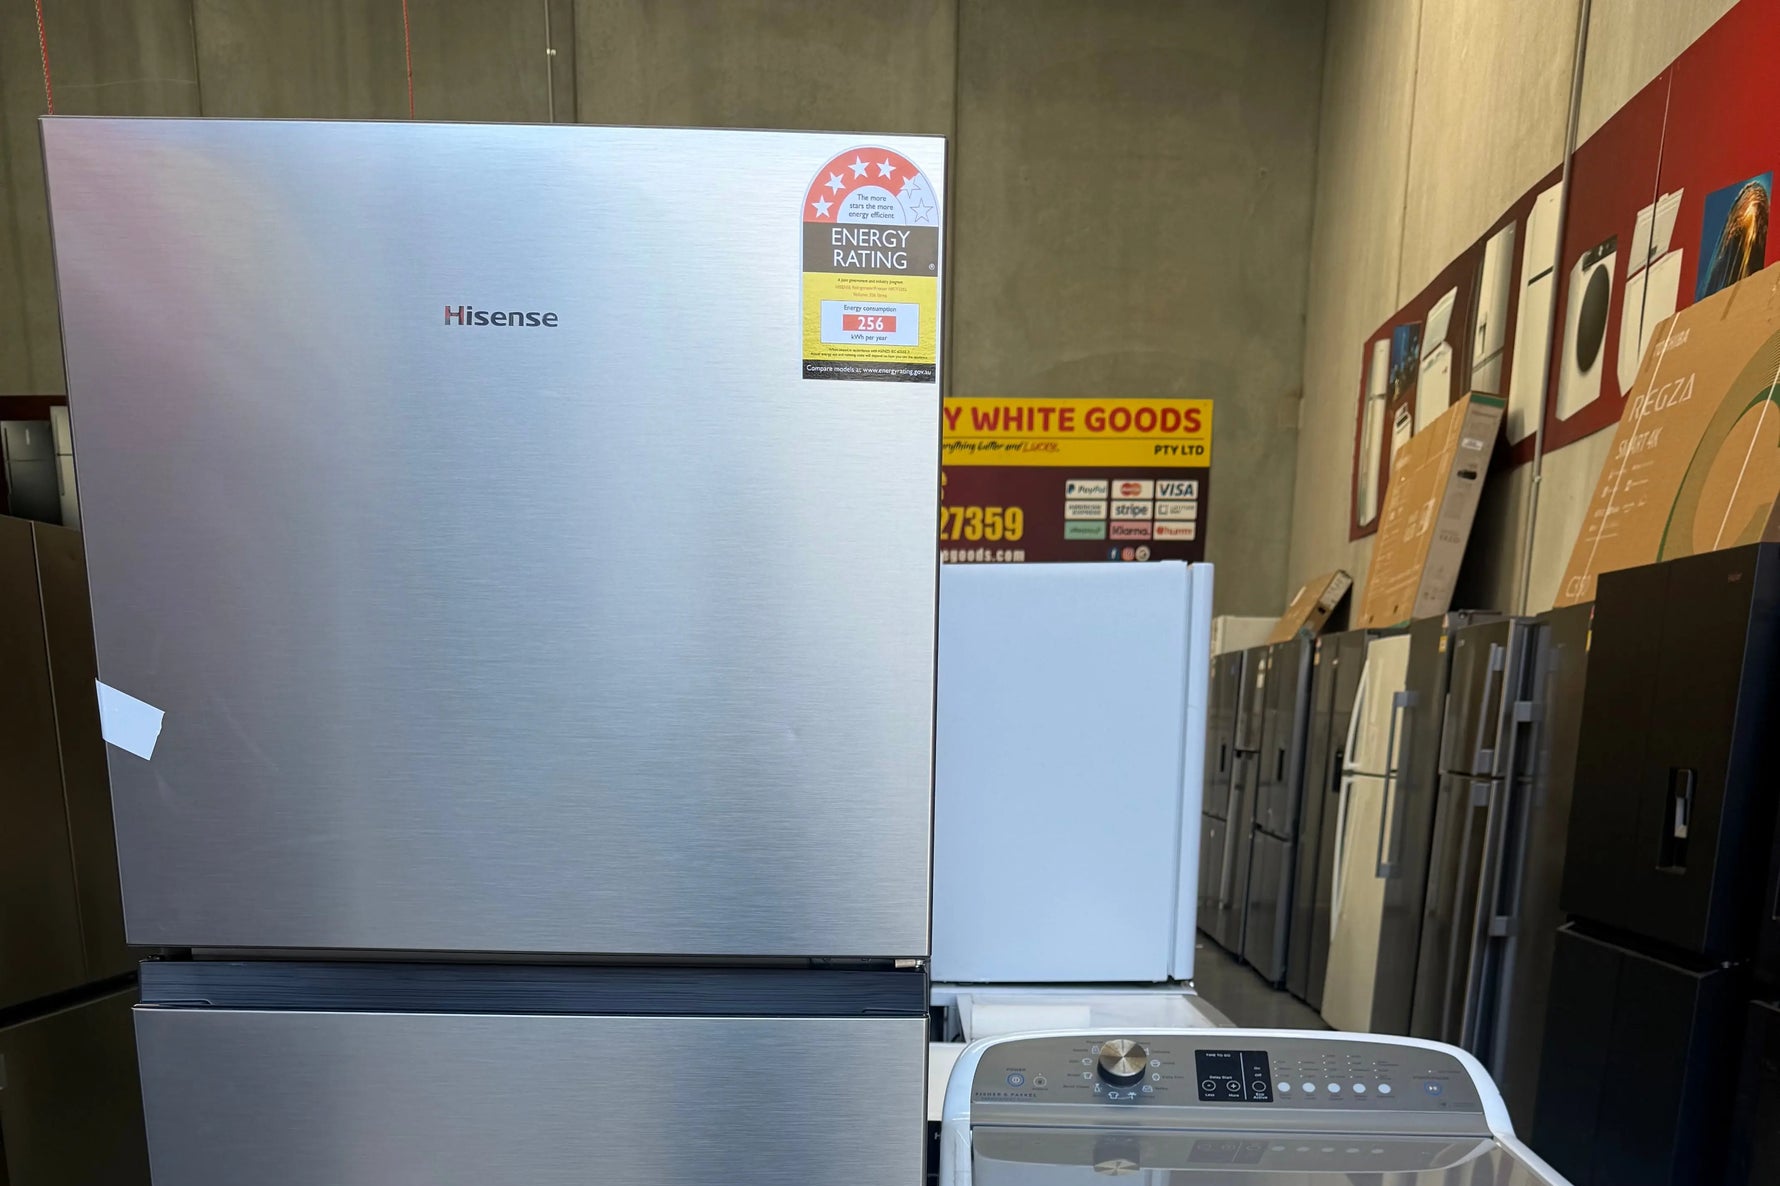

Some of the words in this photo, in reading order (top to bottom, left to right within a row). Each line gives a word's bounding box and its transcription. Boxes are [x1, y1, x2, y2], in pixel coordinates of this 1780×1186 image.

[857, 193, 869, 201] The
[870, 211, 895, 219] efficient
[832, 228, 911, 248] ENERGY
[833, 250, 907, 269] RATING
[843, 304, 862, 312] Energy
[863, 305, 897, 313] consumption
[444, 305, 559, 327] Hisense
[857, 317, 884, 331] 256
[806, 364, 833, 372] Compare
[1628, 373, 1695, 422] REGZA
[971, 406, 1075, 432] WHITE
[1084, 407, 1202, 433] GOODS
[1154, 445, 1178, 456] PTY
[1181, 445, 1204, 456] LTD
[1160, 483, 1194, 497] VISA
[1115, 504, 1149, 518] stripe
